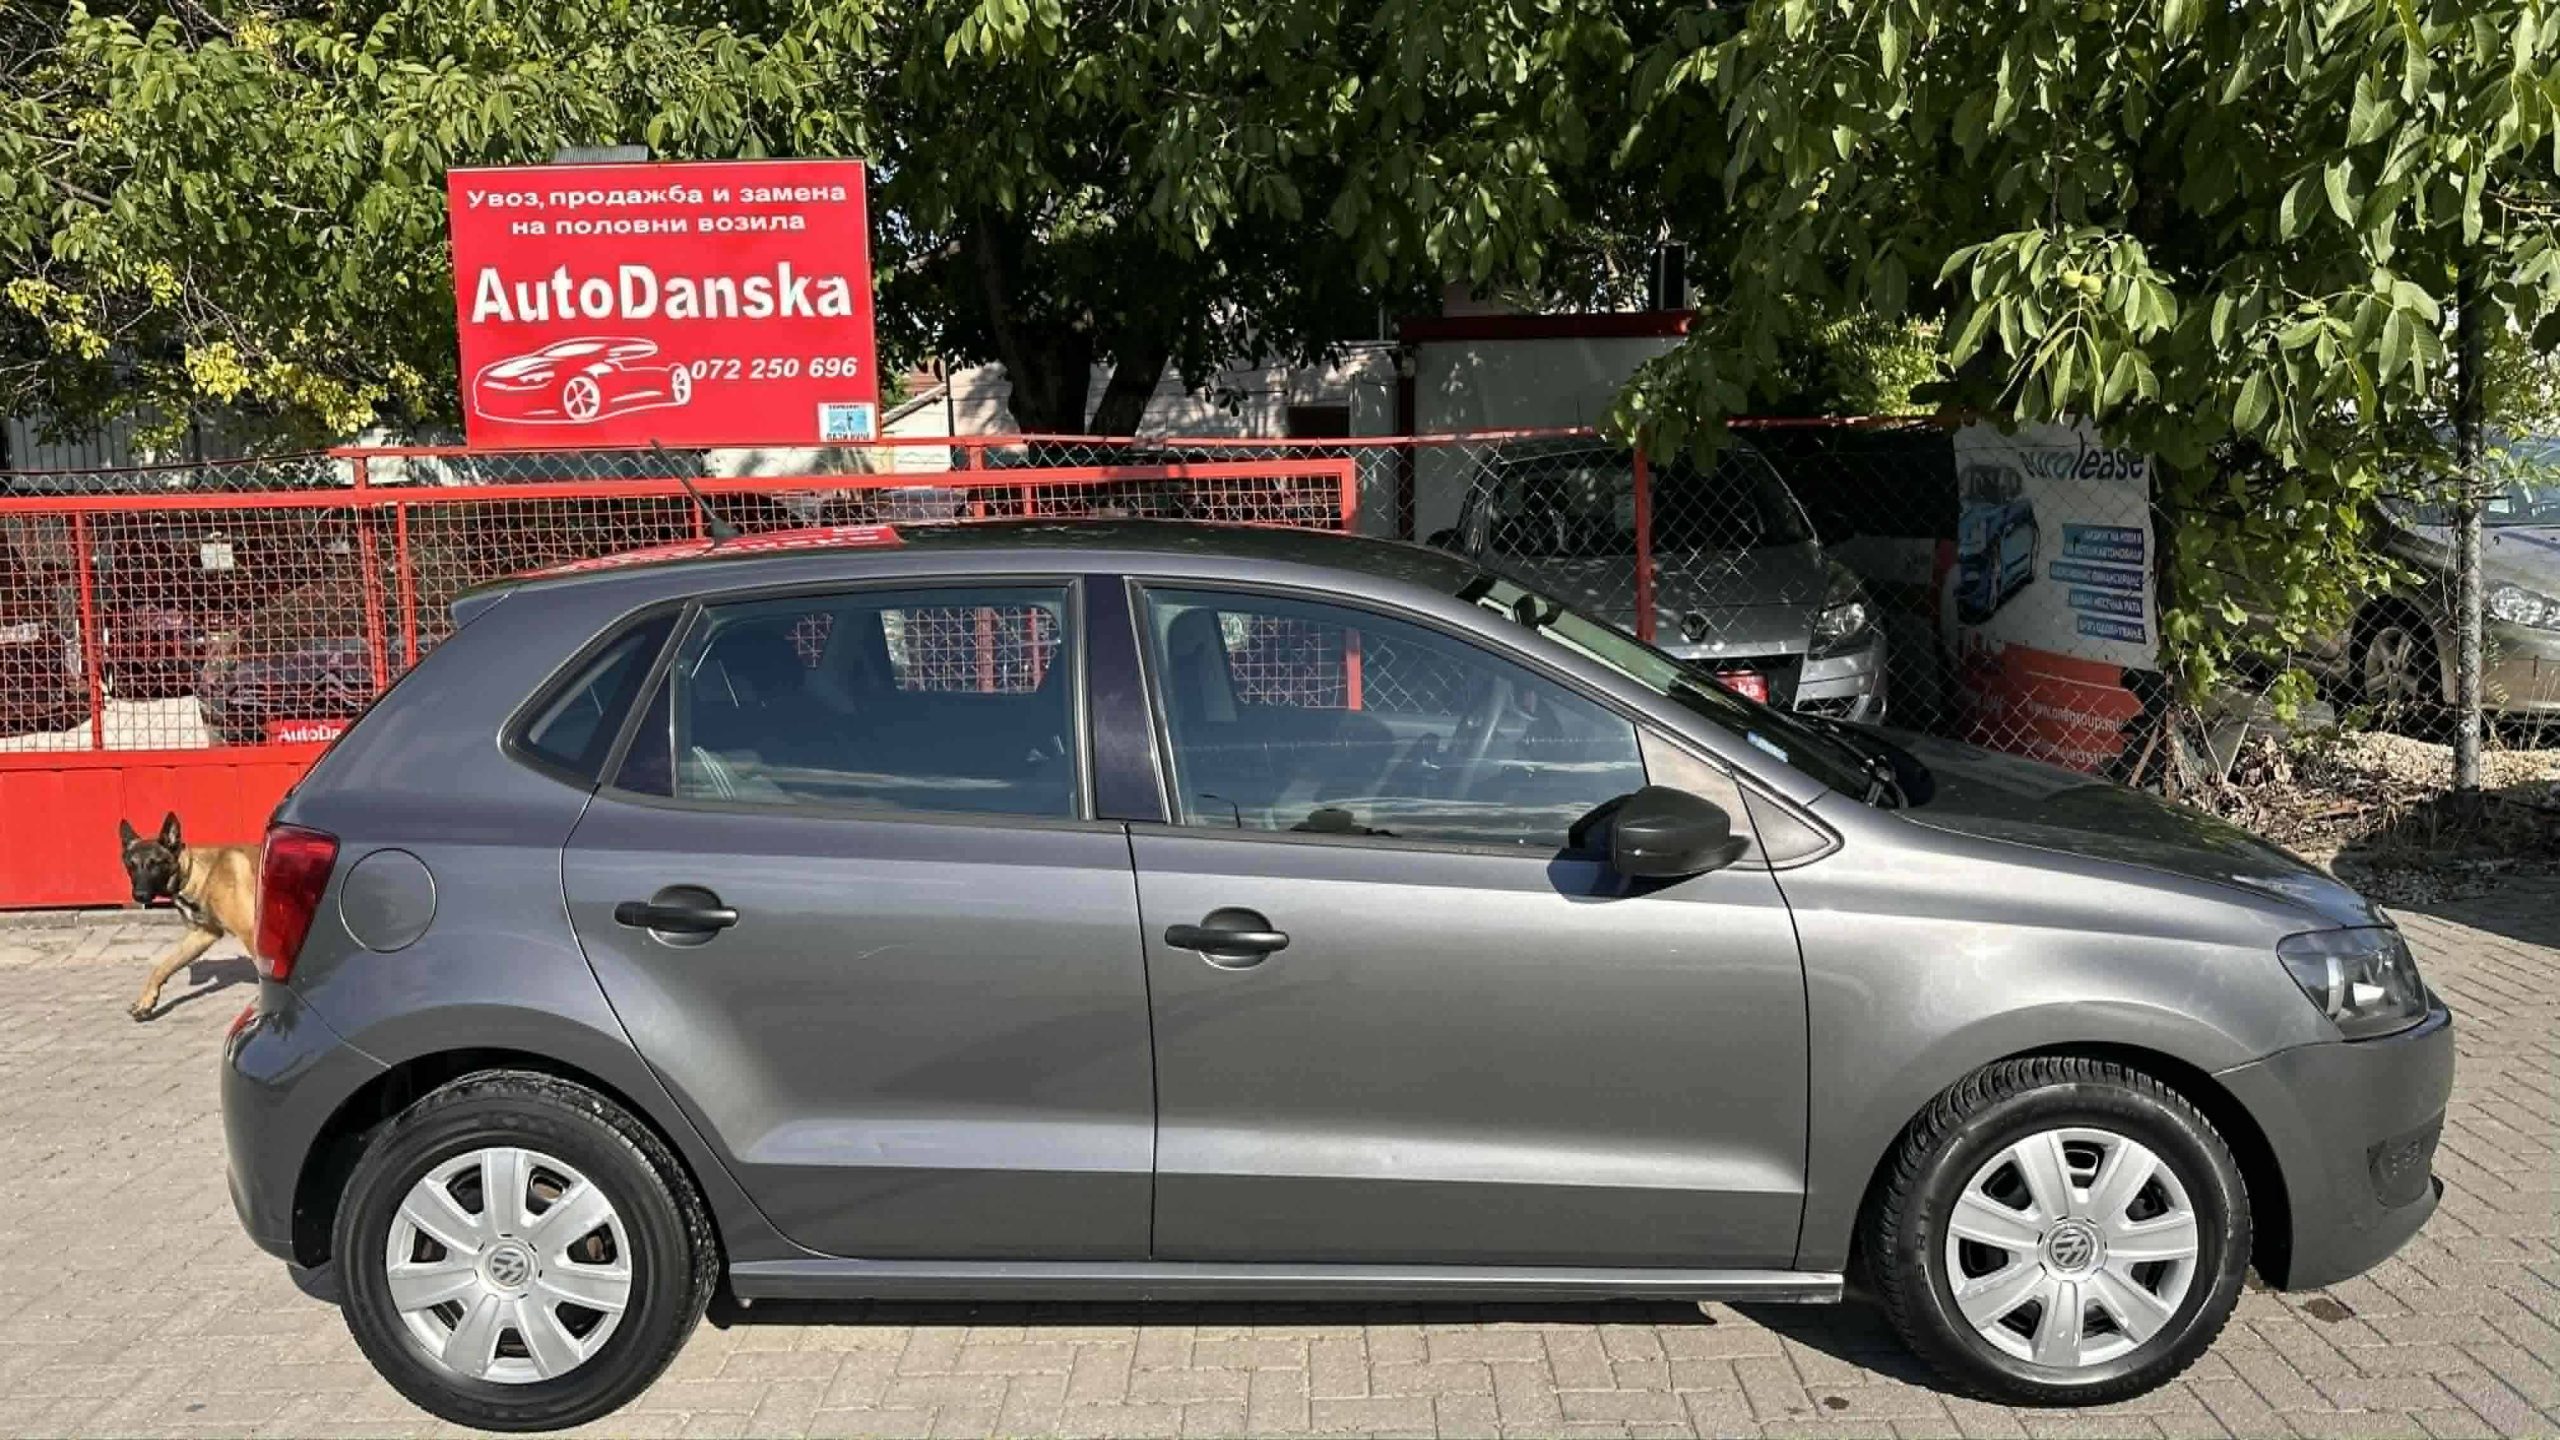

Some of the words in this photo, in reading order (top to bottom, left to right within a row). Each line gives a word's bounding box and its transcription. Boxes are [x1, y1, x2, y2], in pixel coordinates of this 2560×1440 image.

[711, 188, 731, 202] и
[739, 184, 847, 203] замена
[511, 220, 546, 235] на
[556, 217, 688, 235] половни
[698, 213, 806, 233] возила
[471, 261, 852, 323] AutoDanska
[690, 359, 741, 380] 072
[750, 358, 800, 380] 250
[808, 357, 858, 378] 696
